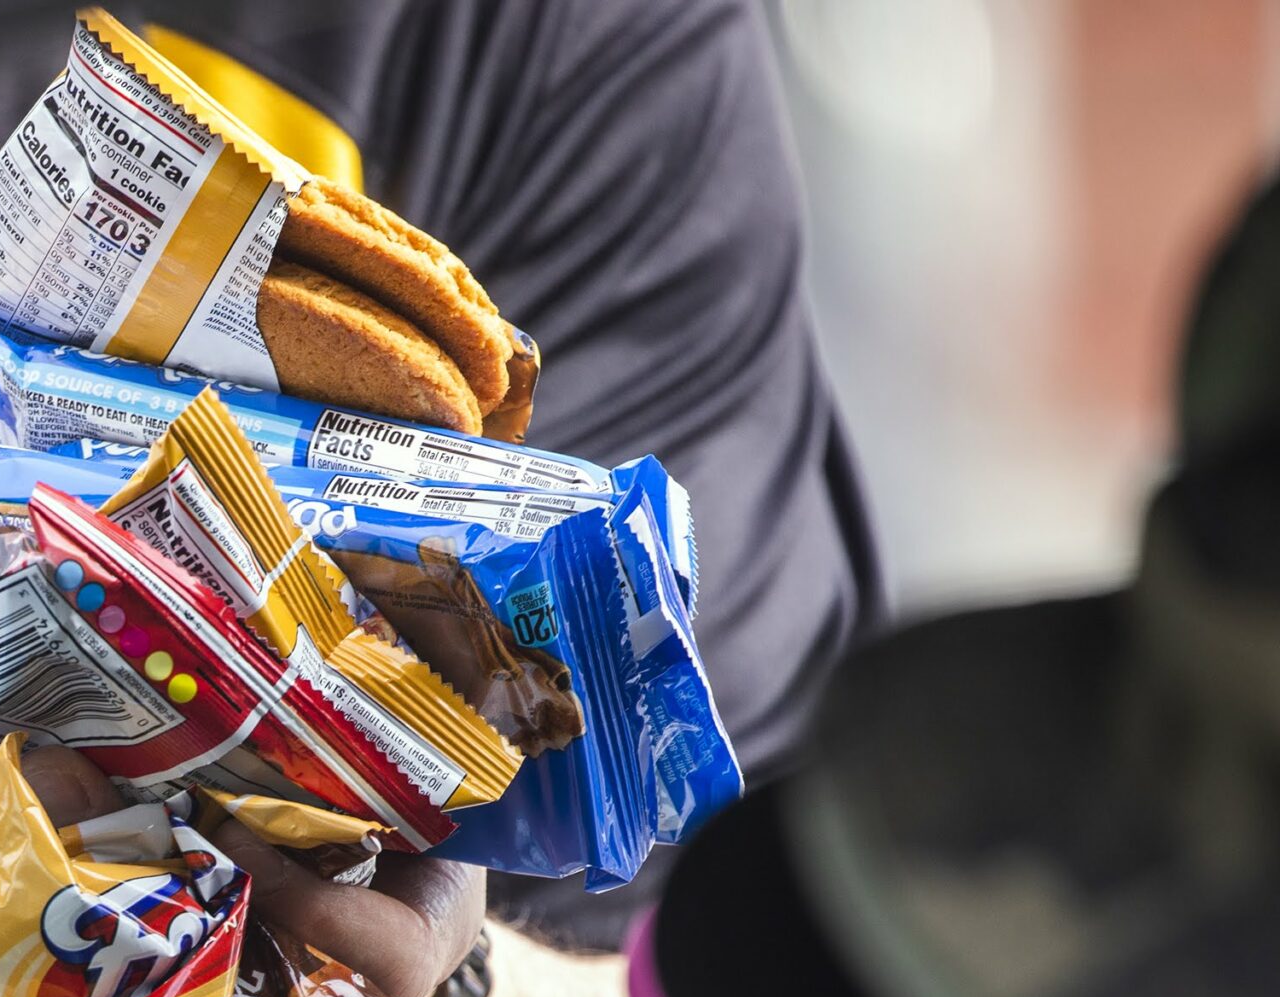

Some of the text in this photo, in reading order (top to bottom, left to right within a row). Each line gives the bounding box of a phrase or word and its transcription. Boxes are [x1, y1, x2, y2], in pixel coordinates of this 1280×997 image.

[116, 64, 125, 72] or
[67, 78, 145, 158] utrition
[142, 95, 152, 105] to
[152, 103, 187, 130] 4:30pm
[1, 151, 20, 180] Total
[20, 179, 32, 199] Fat
[23, 121, 74, 204] Calories
[101, 144, 153, 184] container
[111, 168, 166, 213] 1 cookie
[7, 204, 20, 220] Fat
[92, 190, 135, 222] Per cookie
[84, 202, 129, 241] 170
[28, 209, 41, 226] Fat
[56, 240, 77, 260] 2.5g
[84, 260, 106, 278] 12%
[246, 245, 270, 264] High
[90, 250, 111, 268] 11%
[77, 284, 94, 298] 2%
[228, 277, 243, 291] the
[72, 292, 89, 308] 7%
[205, 317, 238, 333] Allergy
[44, 372, 115, 399] SOURCE
[117, 388, 143, 404] OF
[47, 395, 55, 405] &
[57, 398, 89, 412] READY
[92, 405, 105, 416] TO
[107, 409, 127, 424] EAT!
[130, 414, 144, 426] OR
[314, 429, 374, 461] Facts
[321, 412, 416, 448] Nutrition
[417, 447, 438, 460] Total
[440, 452, 454, 464] Fat
[331, 478, 419, 500] Nutrition
[521, 473, 552, 489] Sodium
[130, 511, 145, 522] 2
[176, 483, 213, 529] Weekdays
[421, 499, 441, 509] Total
[442, 501, 456, 511] Fat
[500, 507, 516, 518] 12%
[520, 509, 551, 524] Sodium
[494, 521, 536, 536] 15% Total
[147, 497, 234, 607] Nutrition
[637, 561, 651, 590] SEAL
[514, 605, 558, 645] 420
[345, 695, 381, 727] Peanut
[426, 776, 443, 792] Oil
